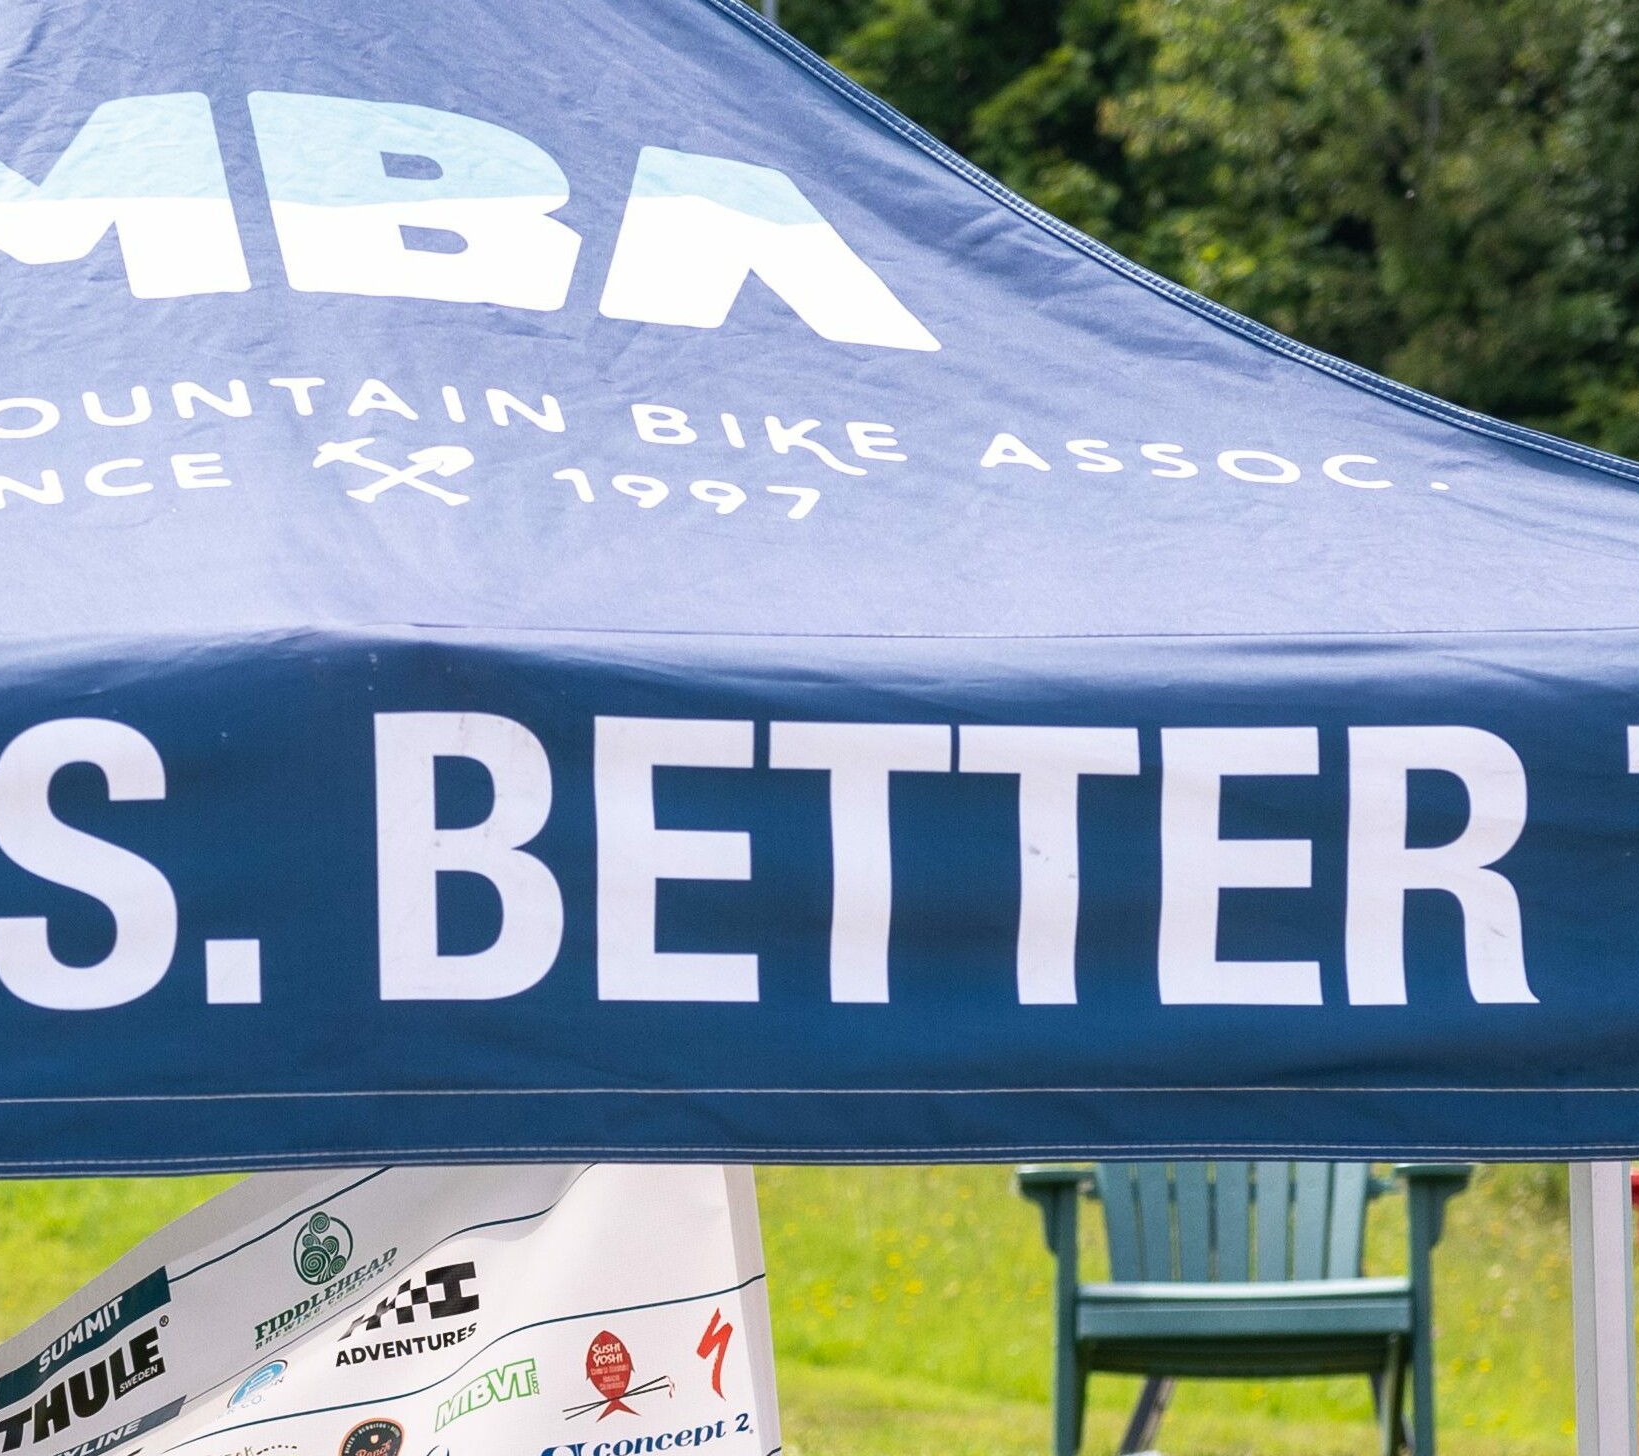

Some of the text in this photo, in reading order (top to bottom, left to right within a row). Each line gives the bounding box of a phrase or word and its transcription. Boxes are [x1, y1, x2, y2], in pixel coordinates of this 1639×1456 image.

[631, 400, 911, 475] BIKE
[977, 430, 1456, 494] ASSOC.
[553, 465, 825, 521] 1997
[374, 710, 1538, 1006] BETTER
[254, 1247, 398, 1341] FIDDLEHEAD
[38, 1296, 124, 1373] SUMMIT
[335, 1322, 477, 1367] ADVENTURES
[120, 1365, 159, 1395] SWEDEN
[735, 1414, 749, 1432] 2
